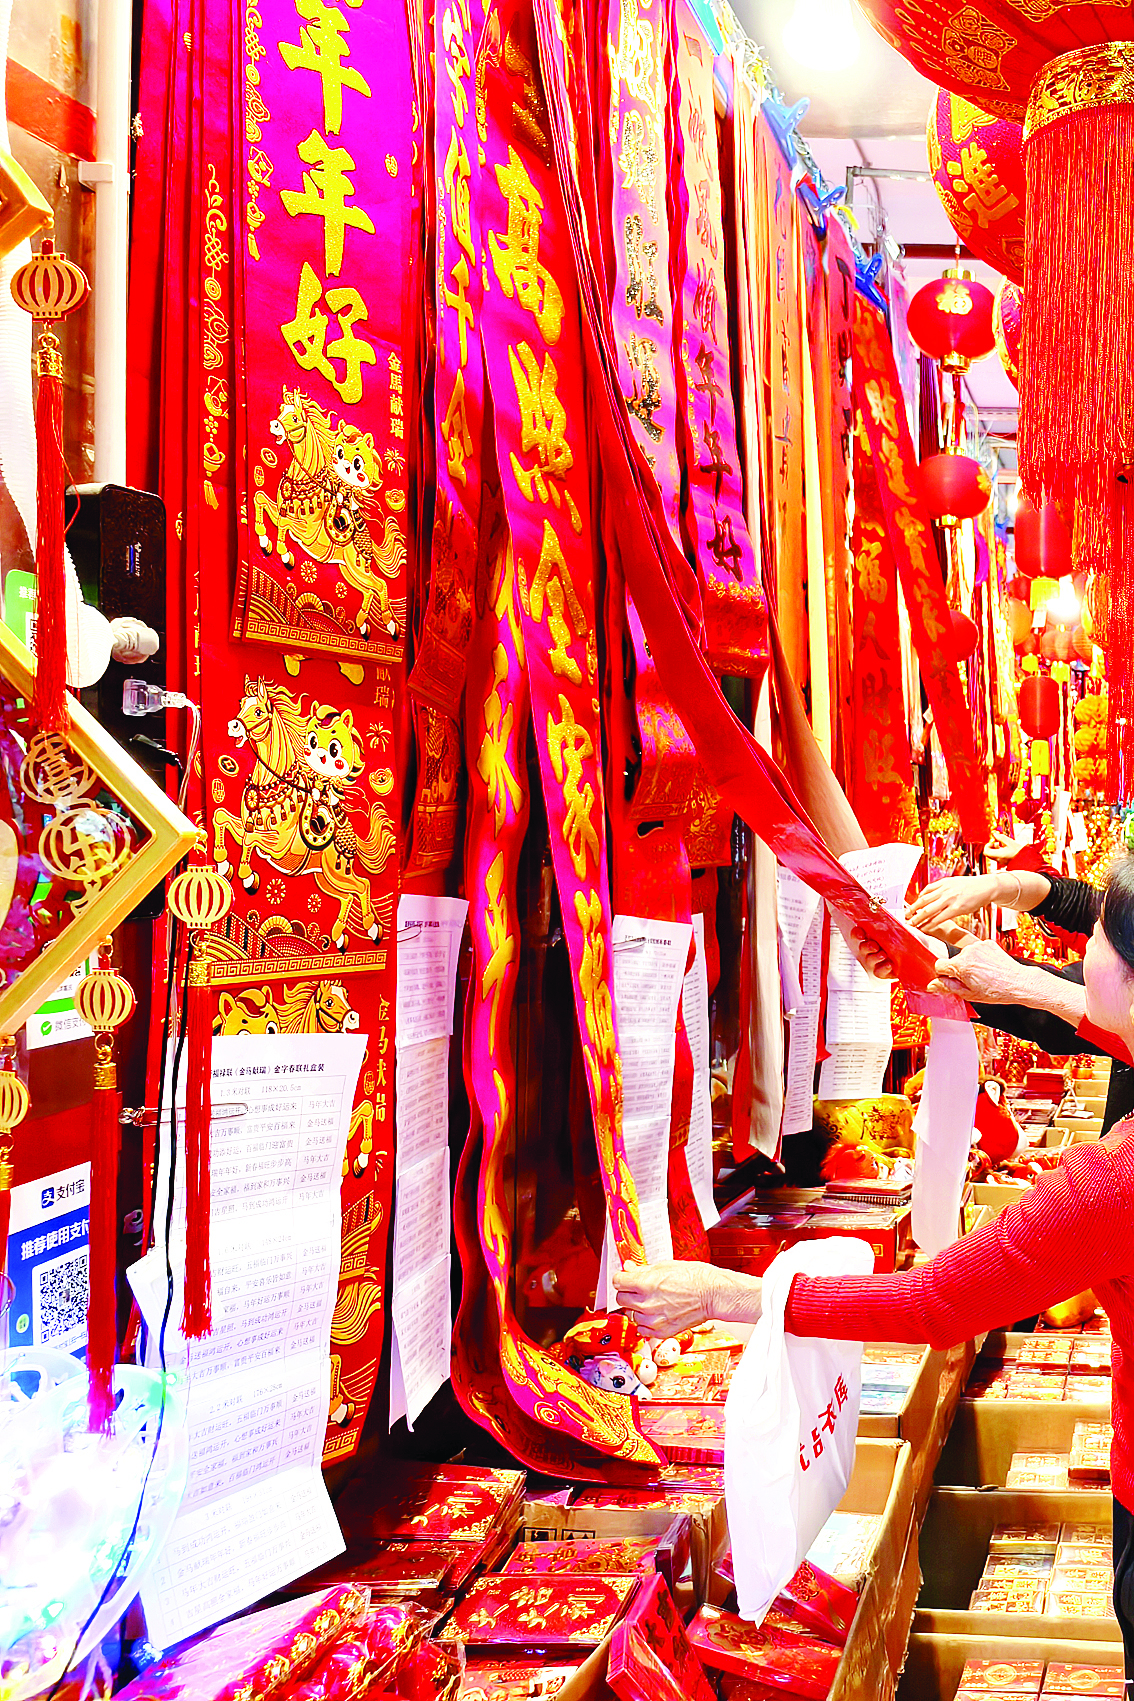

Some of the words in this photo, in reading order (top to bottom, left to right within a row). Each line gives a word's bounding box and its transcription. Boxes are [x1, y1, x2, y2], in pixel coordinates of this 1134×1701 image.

[278, 0, 375, 404] 年年好
[212, 1121, 296, 1138] 吉万事顺，富贵平安百福来
[56, 1179, 85, 1201] 支付宝
